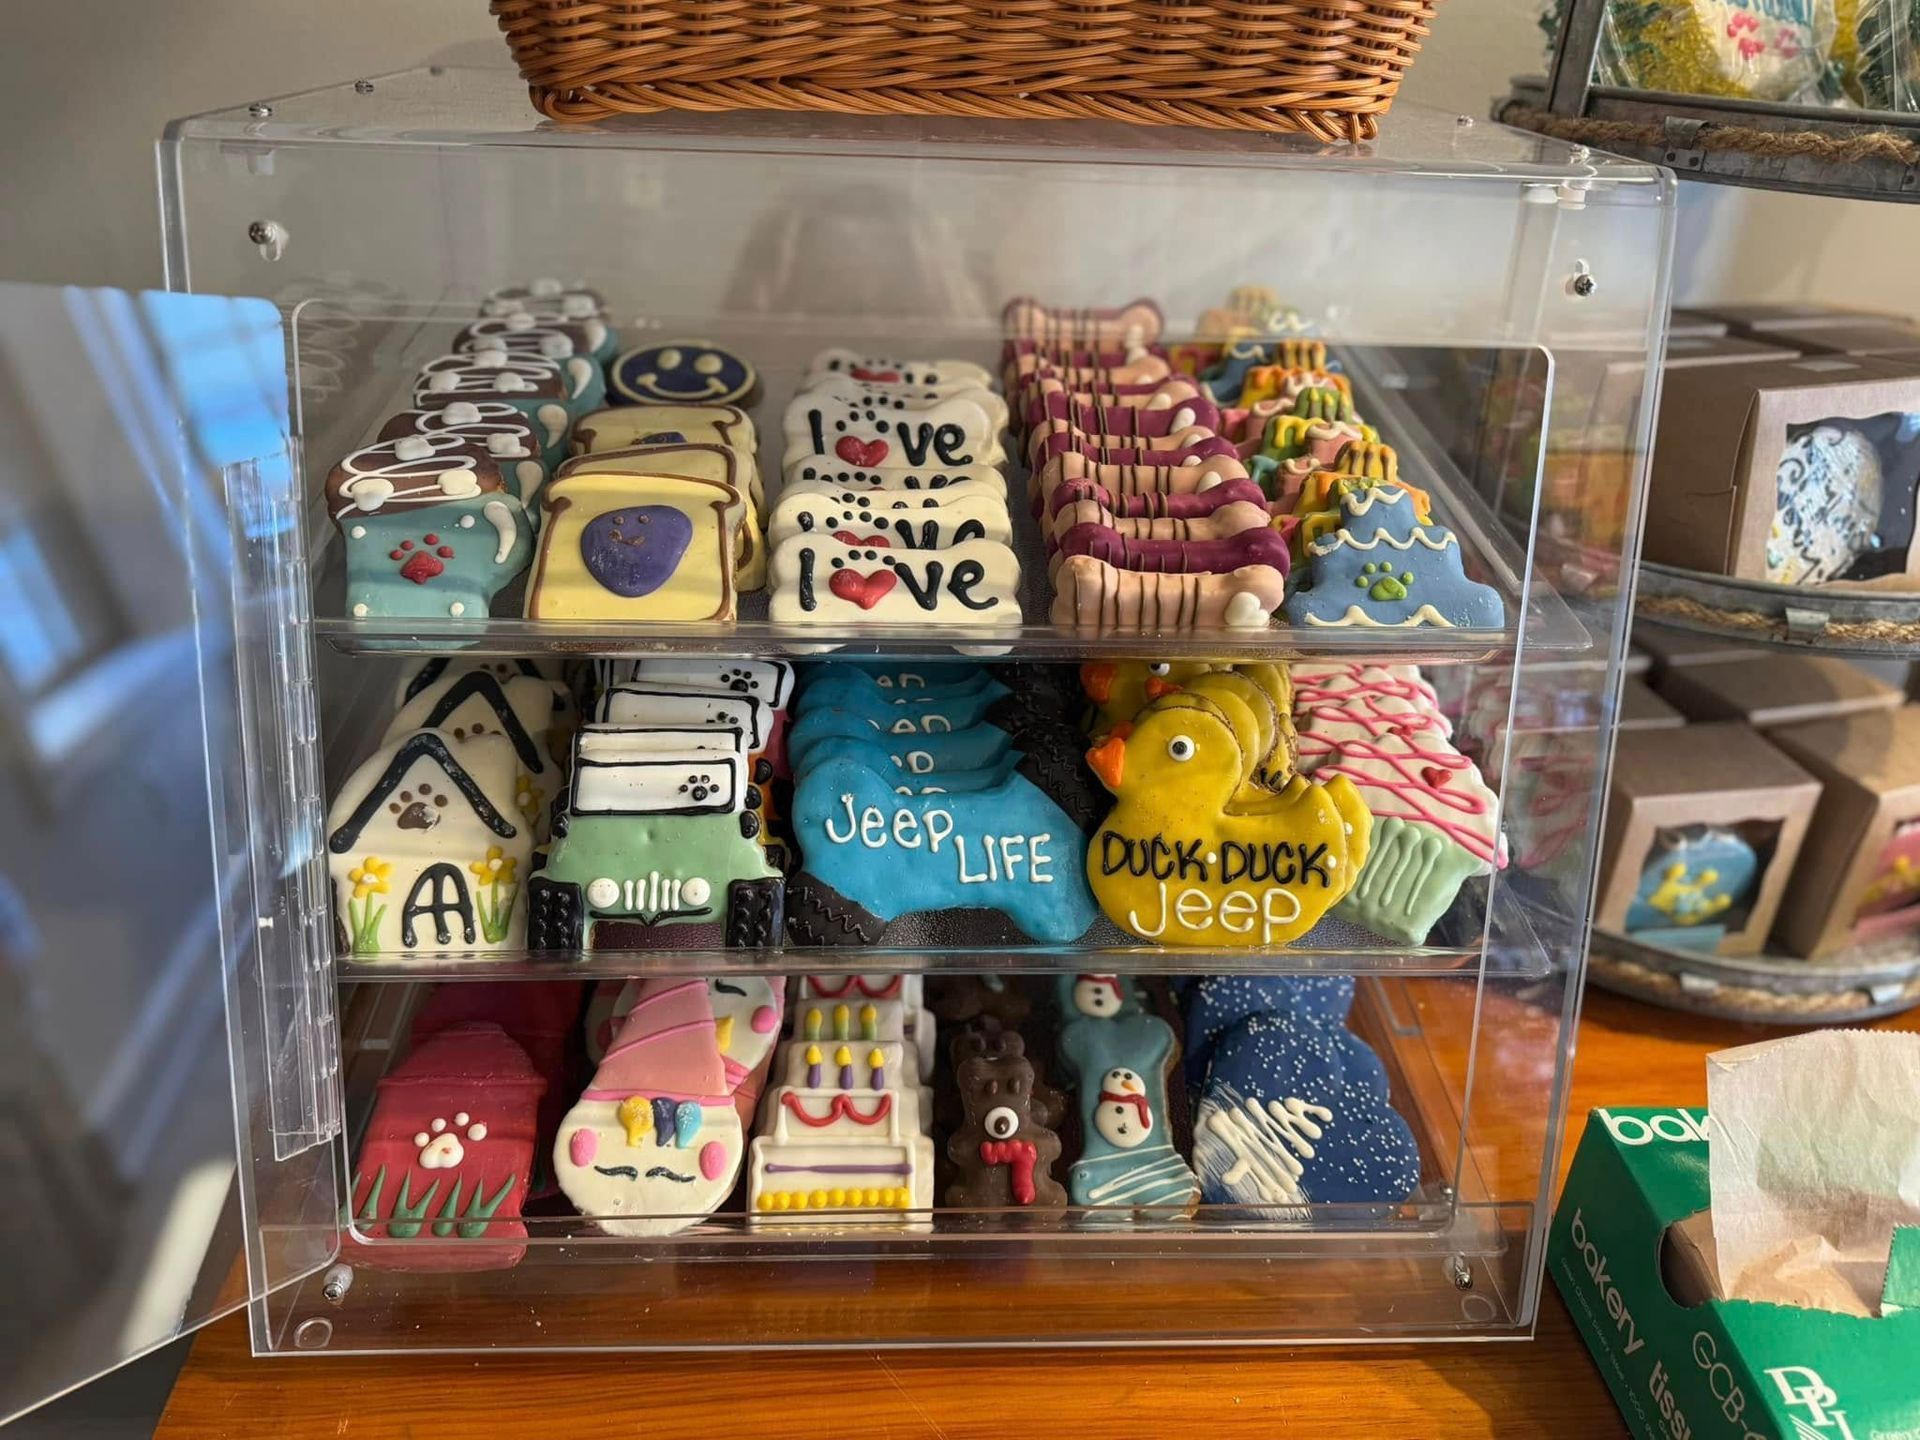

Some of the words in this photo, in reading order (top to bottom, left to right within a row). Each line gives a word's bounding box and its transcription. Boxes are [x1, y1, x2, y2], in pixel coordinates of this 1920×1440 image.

[955, 833, 1054, 884] LIFE
[1102, 830, 1208, 883] DUCK
[1222, 841, 1331, 888] DUCK
[1571, 1207, 1645, 1355] bakery
